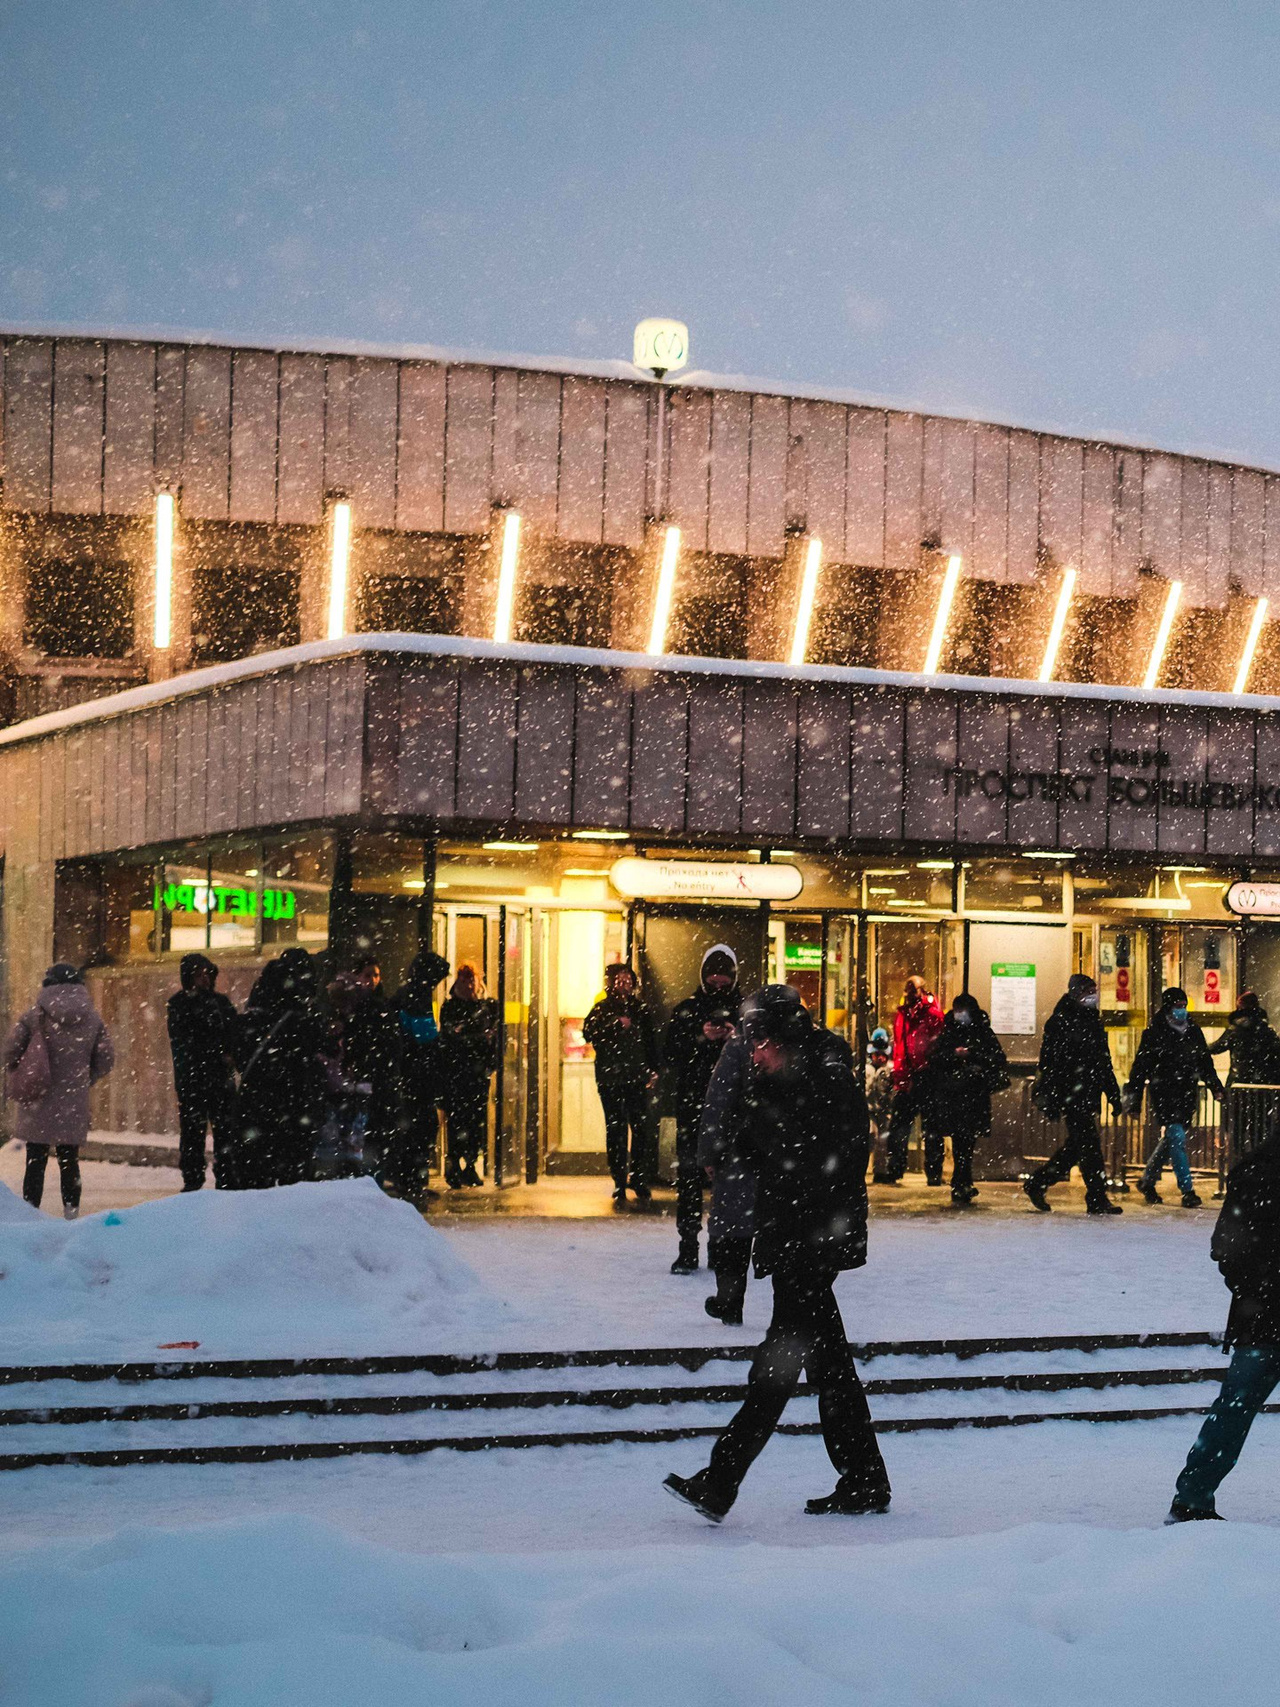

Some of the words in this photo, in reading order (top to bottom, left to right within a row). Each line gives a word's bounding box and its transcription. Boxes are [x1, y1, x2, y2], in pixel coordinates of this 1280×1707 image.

[943, 768, 1095, 801] ПРОСПЕКТ
[673, 881, 688, 890] No
[689, 881, 716, 892] entry
